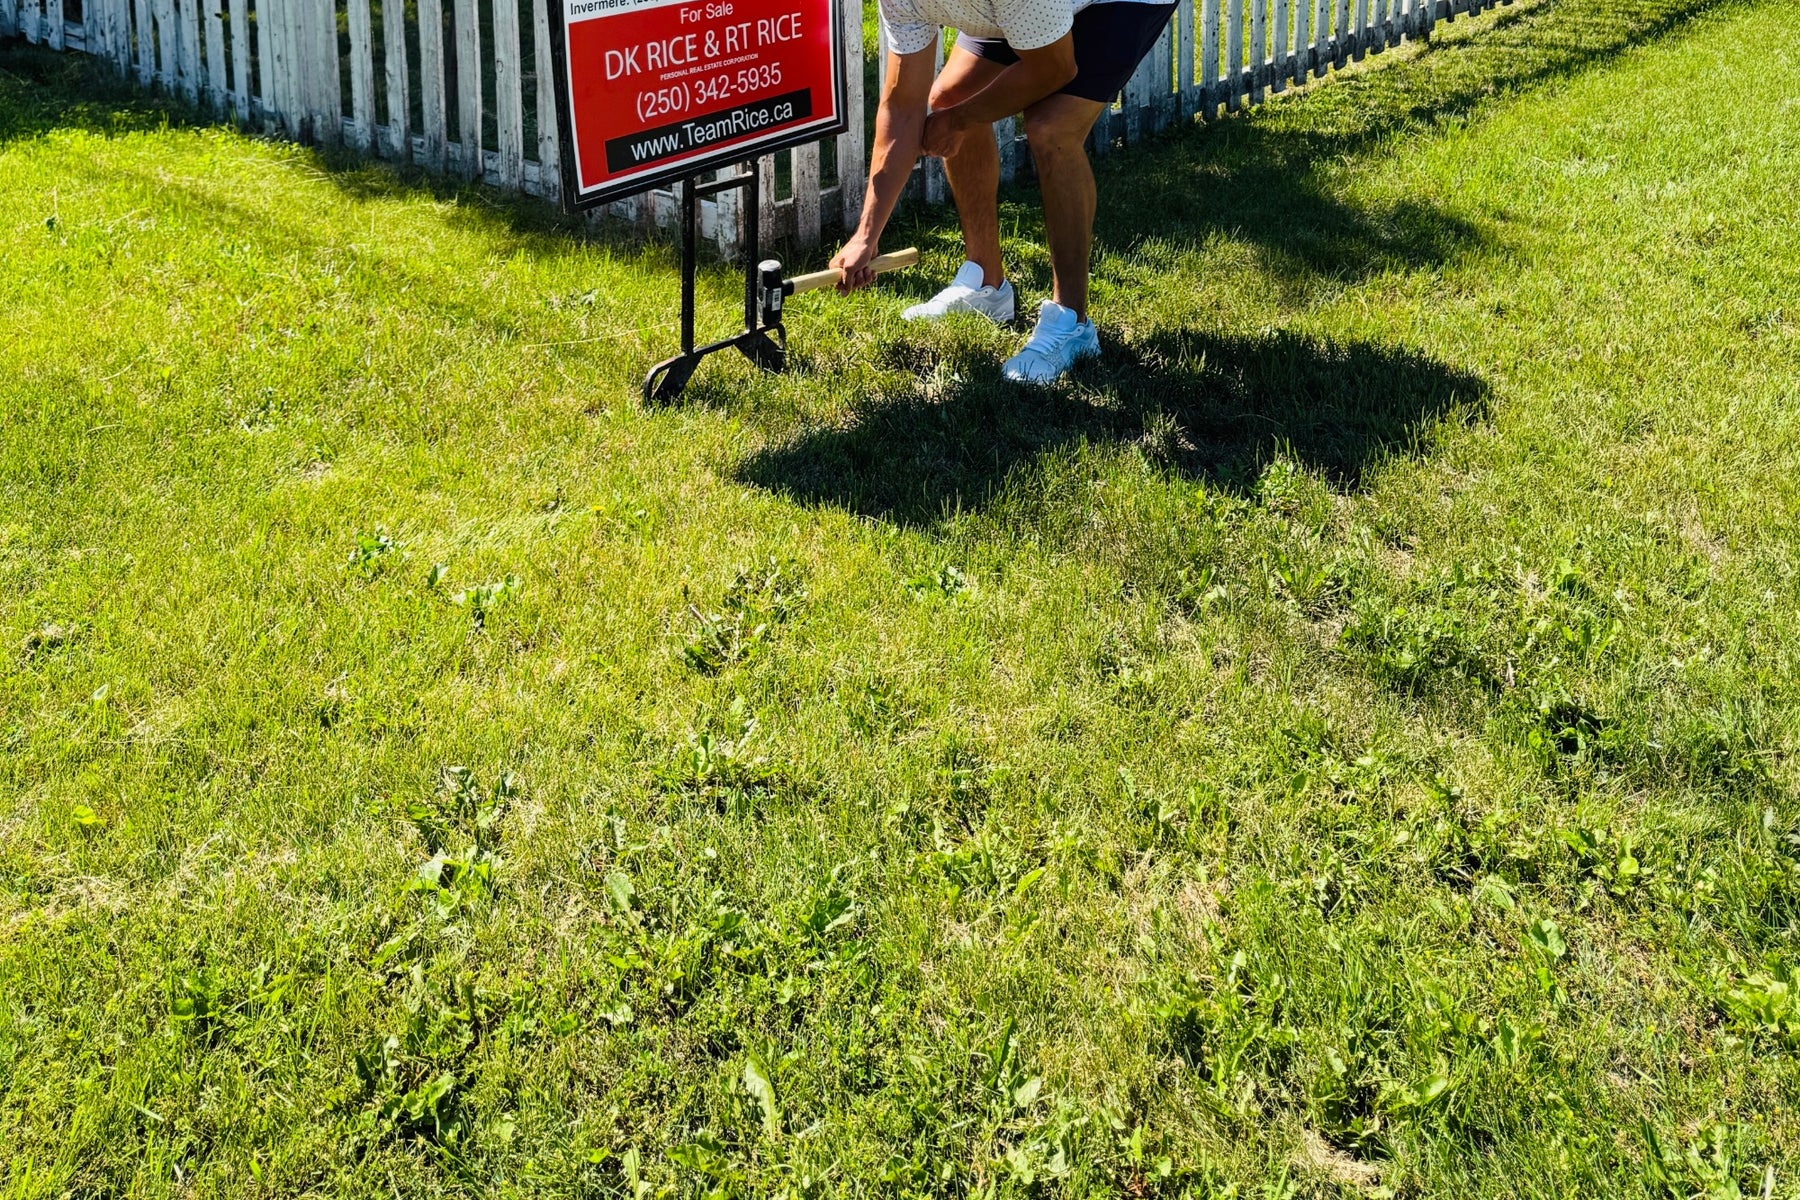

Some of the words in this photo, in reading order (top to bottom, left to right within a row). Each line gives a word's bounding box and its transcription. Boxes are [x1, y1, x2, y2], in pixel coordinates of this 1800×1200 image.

[679, 7, 702, 25] For
[705, 1, 734, 20] Sale
[604, 45, 642, 81] DK
[646, 33, 699, 71] RICE
[703, 30, 721, 58] &
[725, 22, 752, 54] RT
[757, 12, 803, 47] RICE
[660, 69, 689, 81] PERSONAL
[689, 65, 704, 74] REAL
[703, 61, 723, 71] ESTATE
[723, 53, 759, 66] CORPORATION
[636, 82, 690, 123] (250)
[694, 62, 782, 105] 342-5935
[631, 101, 793, 161] www.TeamRice.ca
